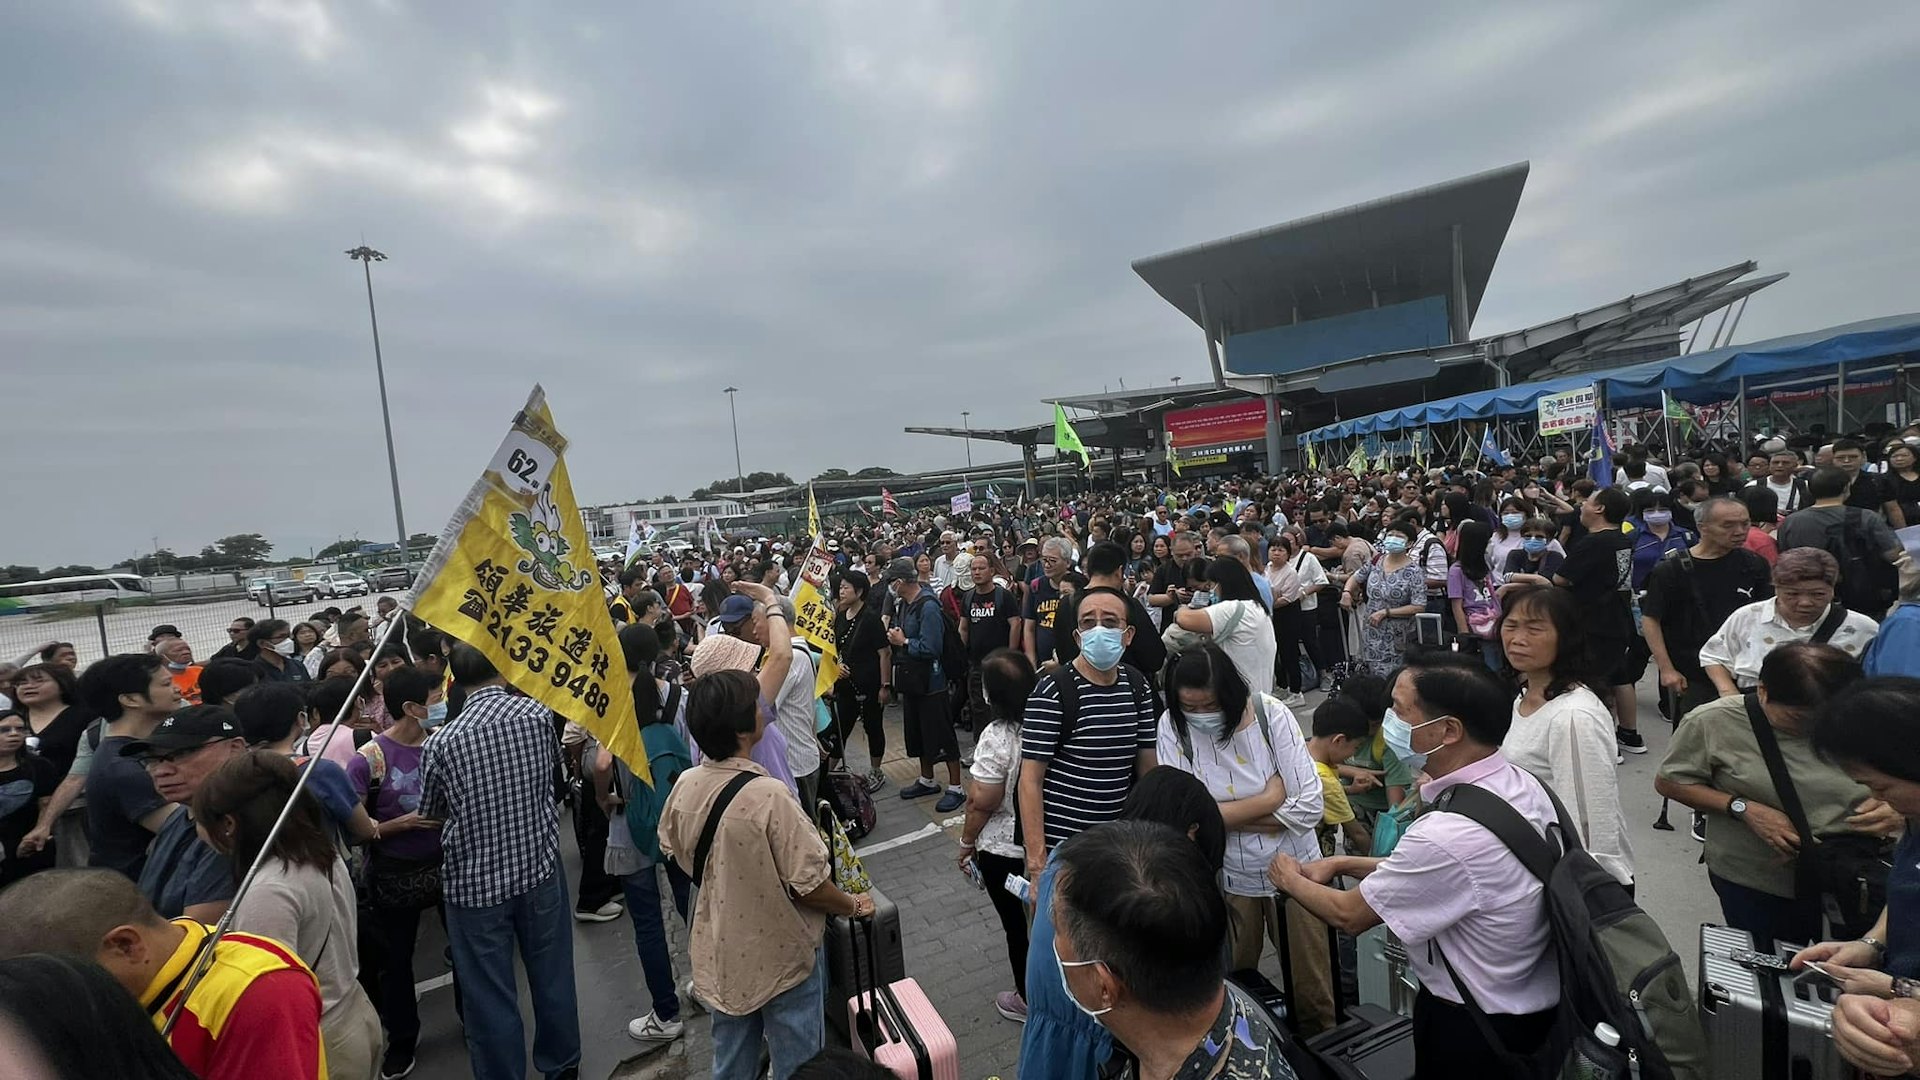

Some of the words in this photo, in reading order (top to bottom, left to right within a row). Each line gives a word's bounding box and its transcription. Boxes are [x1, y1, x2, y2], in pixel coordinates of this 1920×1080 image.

[1557, 393, 1594, 407] 美味假期
[508, 448, 538, 484] 62
[808, 562, 822, 575] 39
[474, 558, 609, 681] 領華旅遊社
[806, 621, 834, 644] 2133
[487, 610, 549, 673] 2133
[551, 662, 610, 718] 9488
